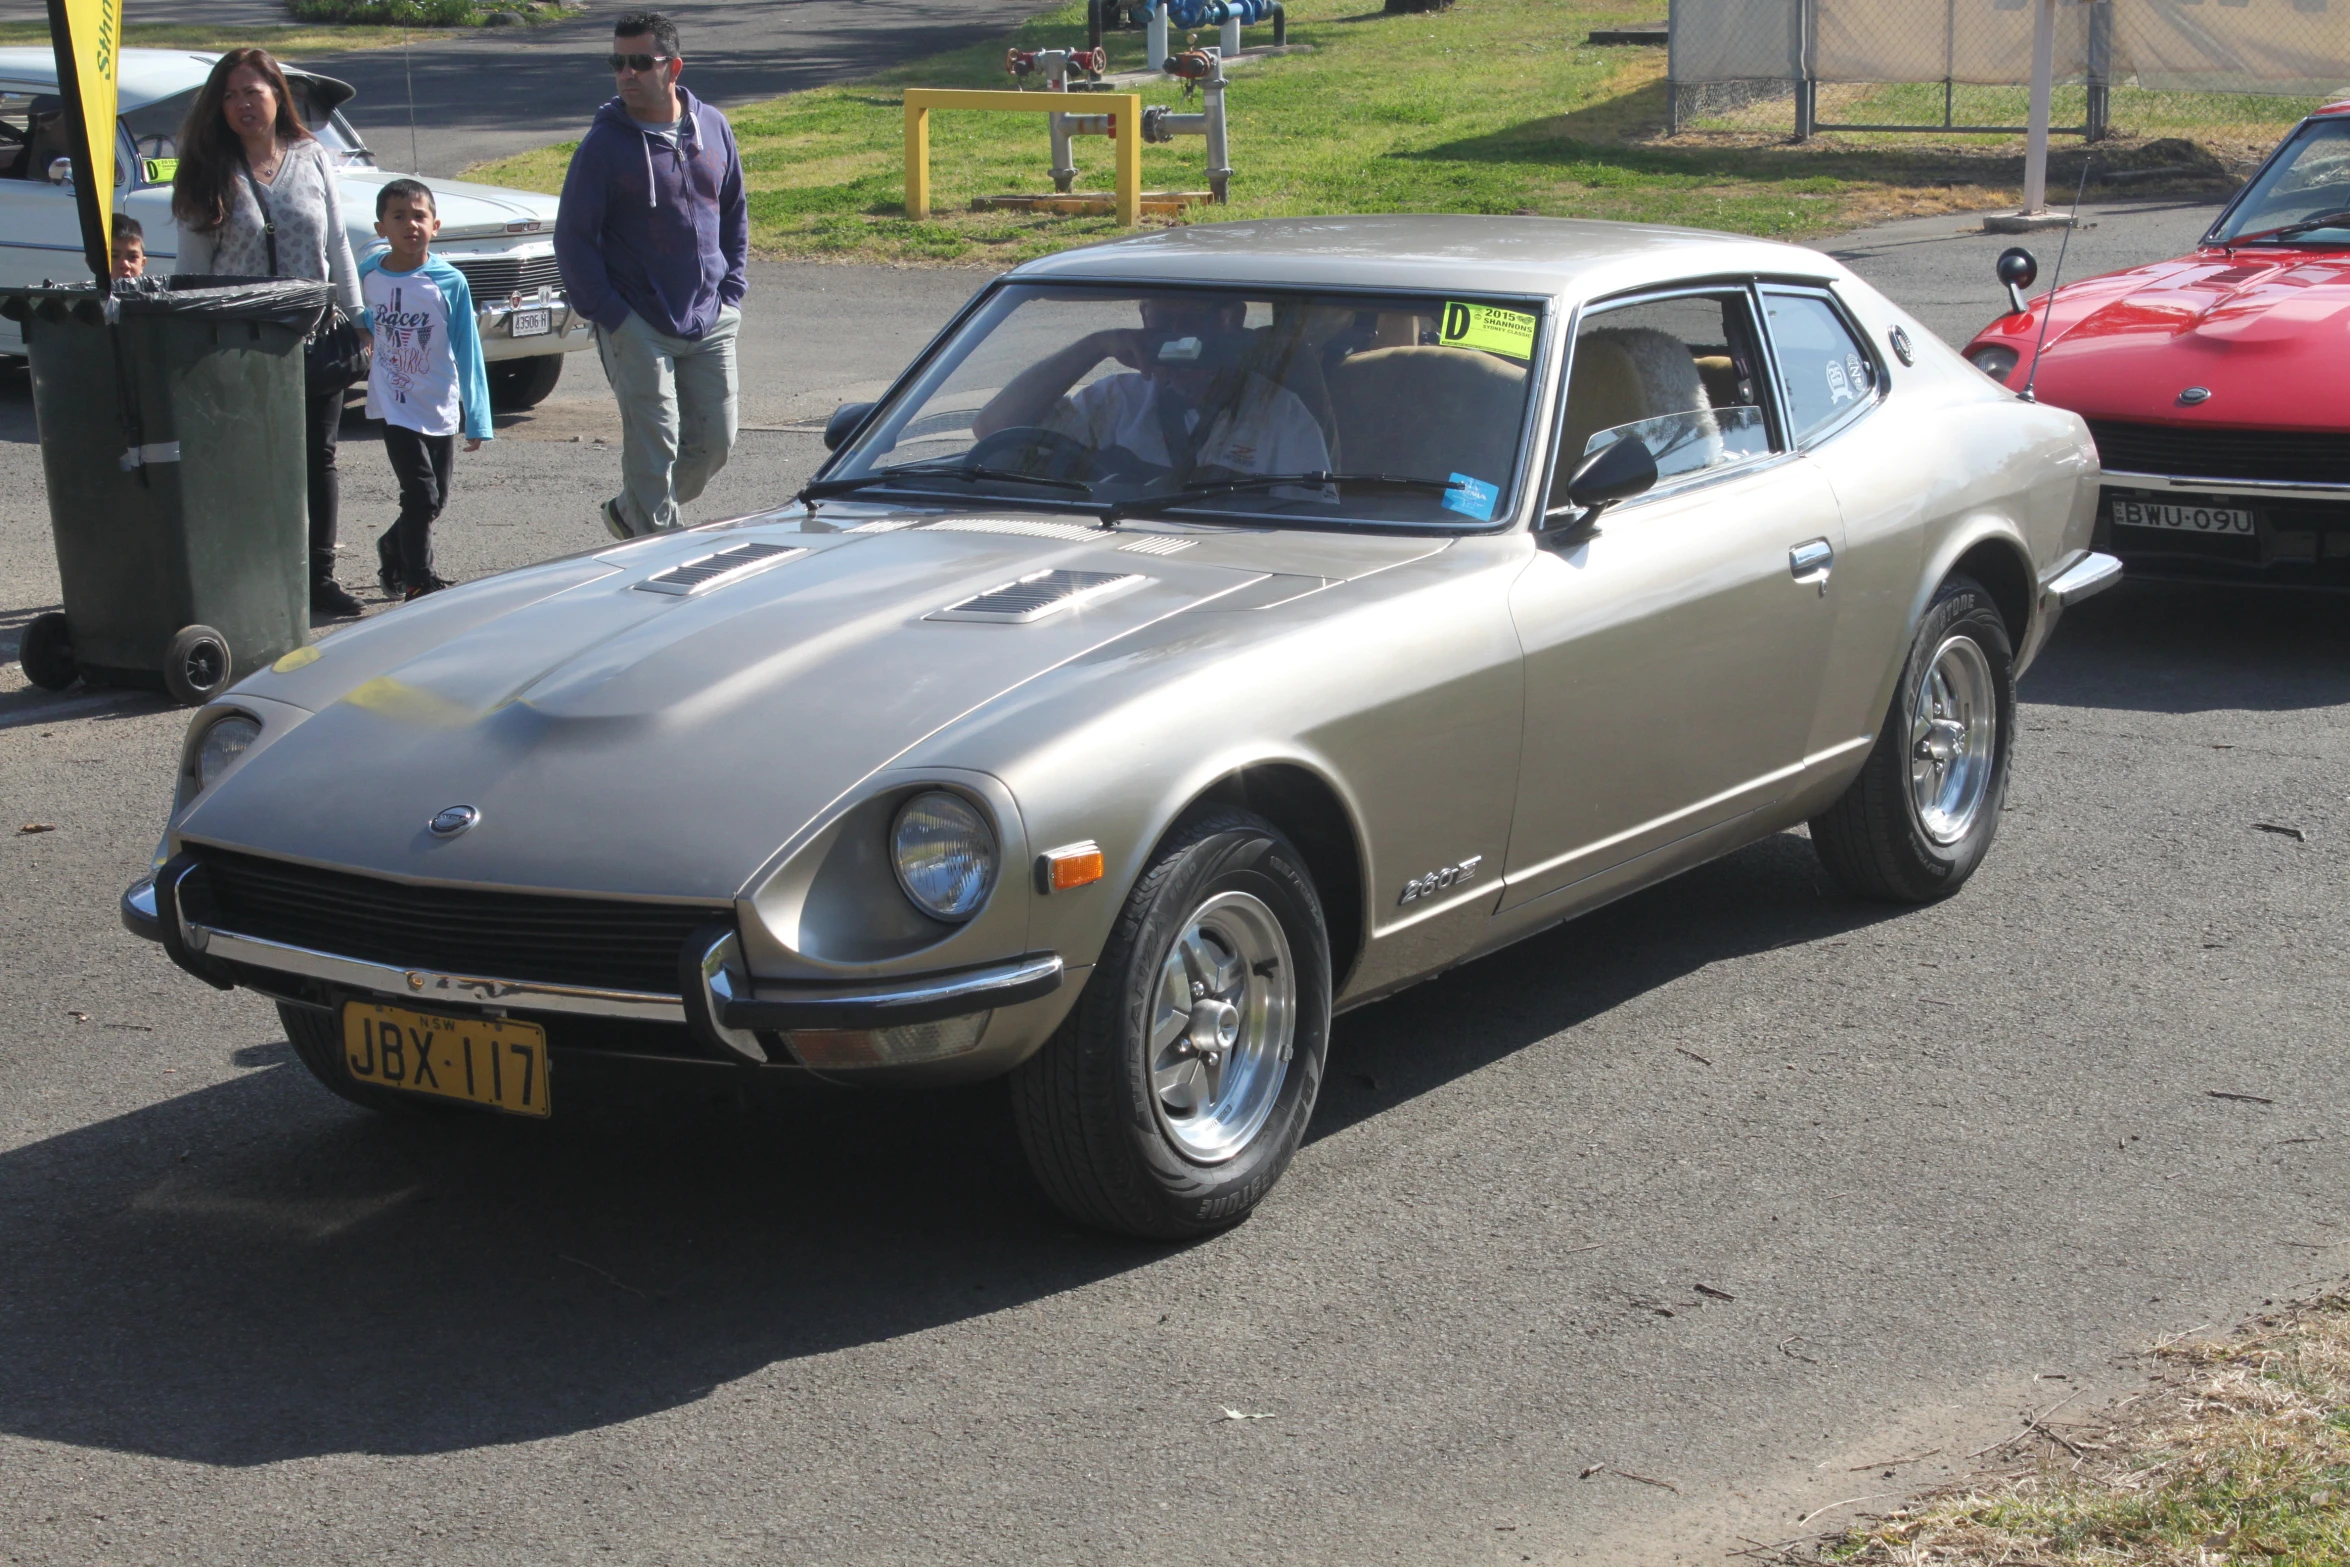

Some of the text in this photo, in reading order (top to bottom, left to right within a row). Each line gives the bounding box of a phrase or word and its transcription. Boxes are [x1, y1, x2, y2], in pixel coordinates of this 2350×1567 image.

[146, 161, 159, 180] D
[374, 304, 431, 326] Racer
[515, 312, 547, 330] 43506 H
[1445, 303, 1471, 341] D
[1484, 308, 1516, 322] 2015
[1482, 324, 1506, 333] SYDNEY
[1507, 328, 1532, 339] CLASSIC
[1483, 318, 1533, 333] SHANNONS
[420, 1015, 456, 1032] NSW
